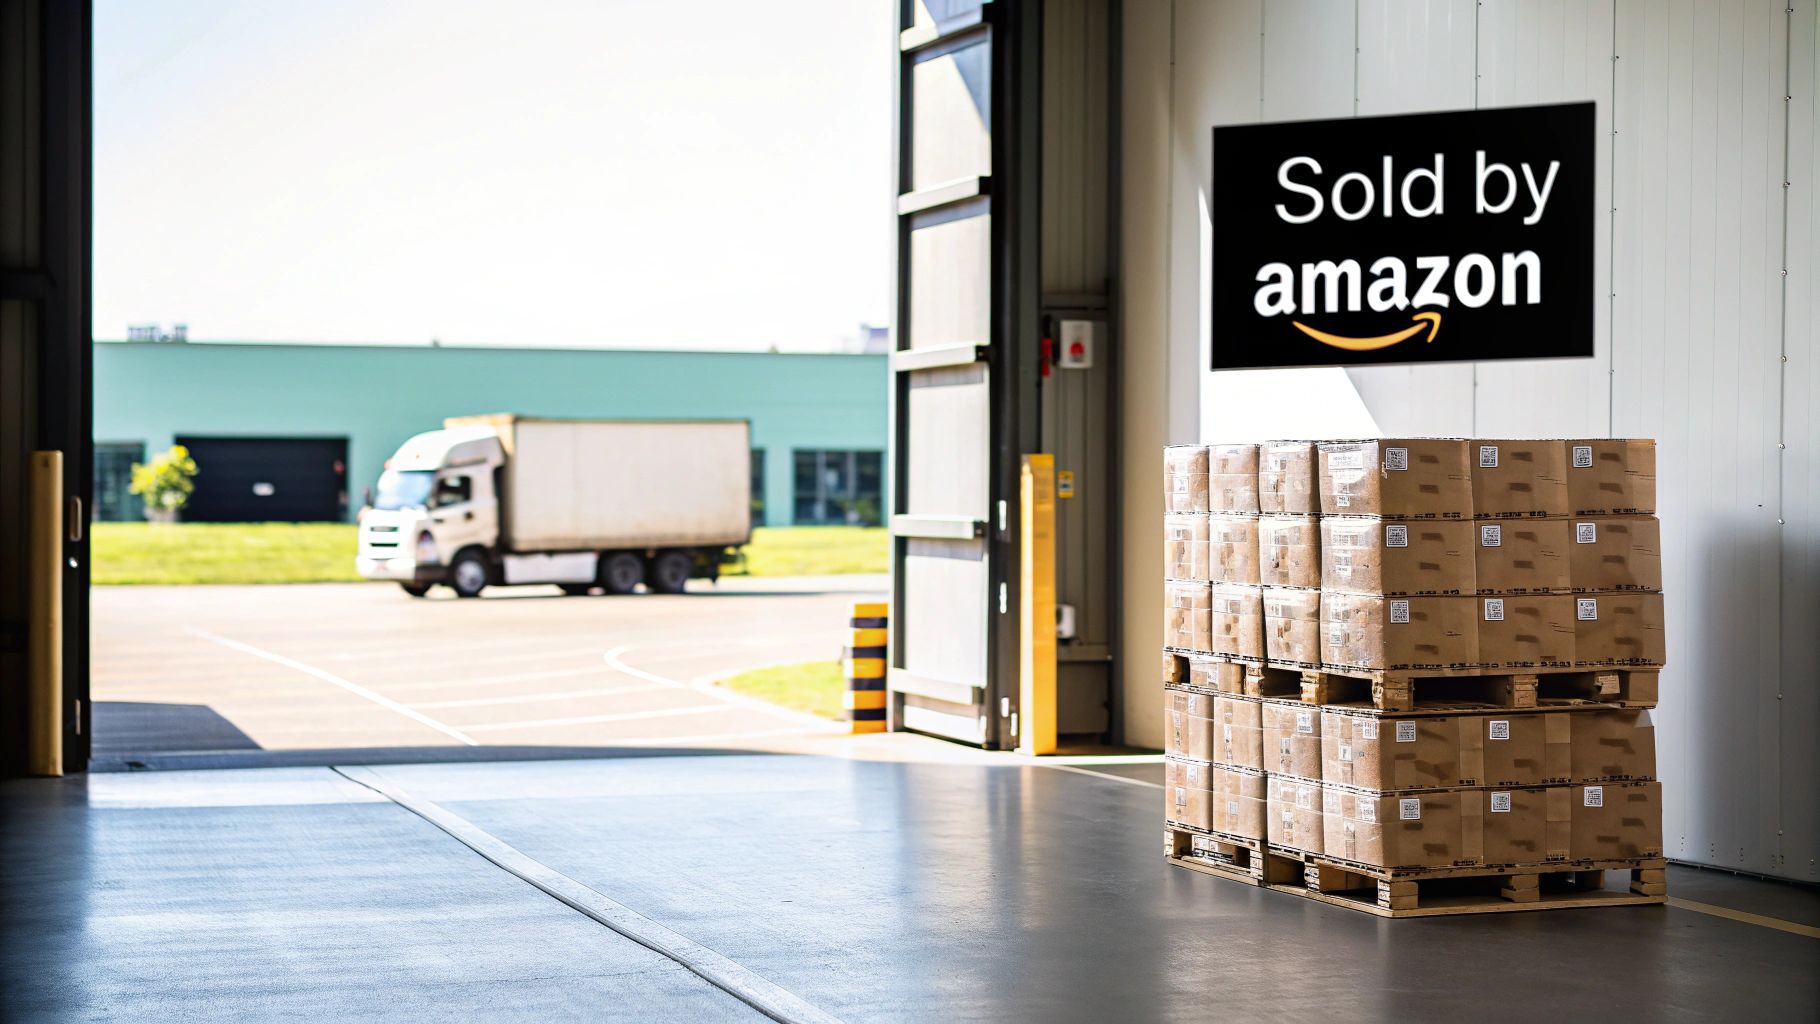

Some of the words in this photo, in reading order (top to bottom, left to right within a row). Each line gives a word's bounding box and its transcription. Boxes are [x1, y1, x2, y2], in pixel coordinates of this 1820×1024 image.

[1275, 152, 1445, 224] Sold
[1475, 150, 1561, 225] by
[1253, 250, 1541, 317] amazon
